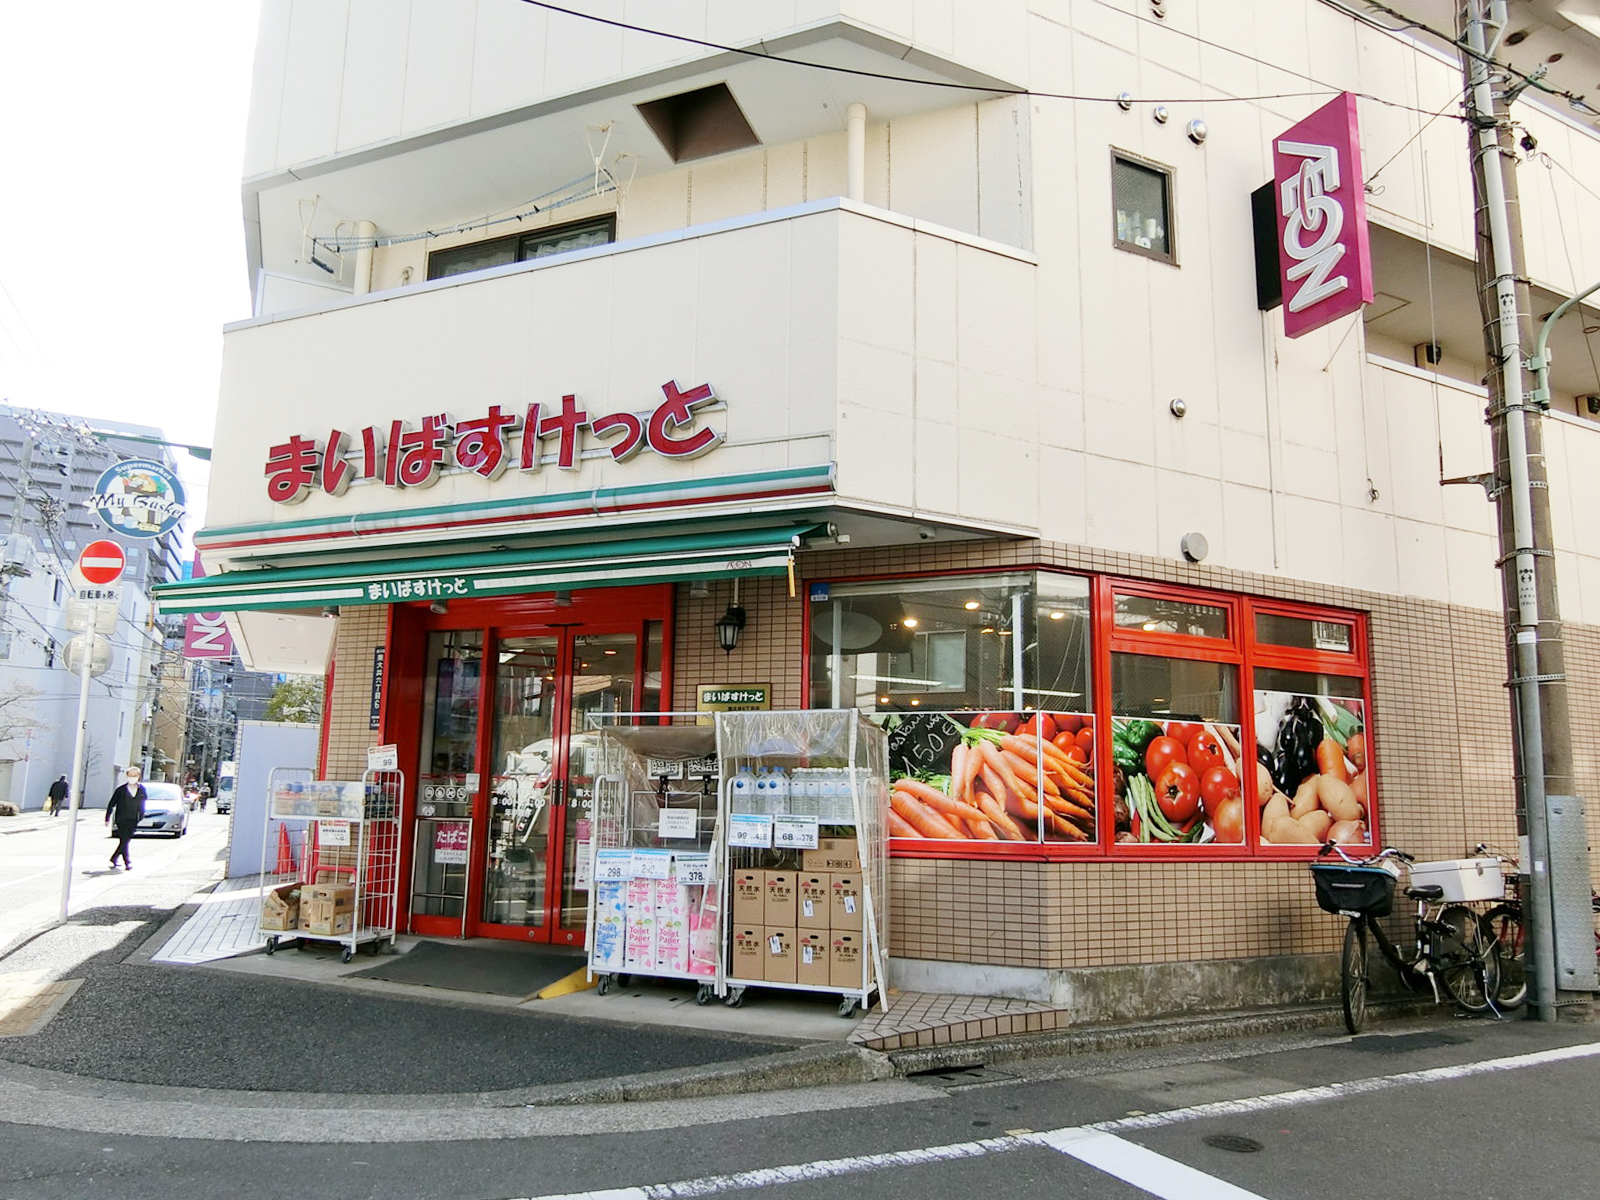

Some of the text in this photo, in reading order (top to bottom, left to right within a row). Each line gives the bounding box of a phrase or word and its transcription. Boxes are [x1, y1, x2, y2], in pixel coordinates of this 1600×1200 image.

[264, 378, 722, 505] まいばすけっと
[115, 462, 173, 480] Supermarket
[90, 493, 186, 518] My Basket
[368, 577, 468, 600] まいばすけっと
[703, 691, 764, 702] まいばすけっと
[436, 830, 468, 843] たばこ
[801, 834, 814, 842] 378
[607, 867, 621, 877] 298
[688, 872, 704, 881] 378
[629, 880, 650, 890] Paper
[657, 880, 678, 889] Paper
[597, 930, 617, 939] Paper
[629, 926, 650, 934] Toilet
[659, 928, 679, 937] Toilet
[629, 934, 651, 942] Paper
[658, 936, 680, 944] Paper
[835, 946, 858, 954] 天然水
